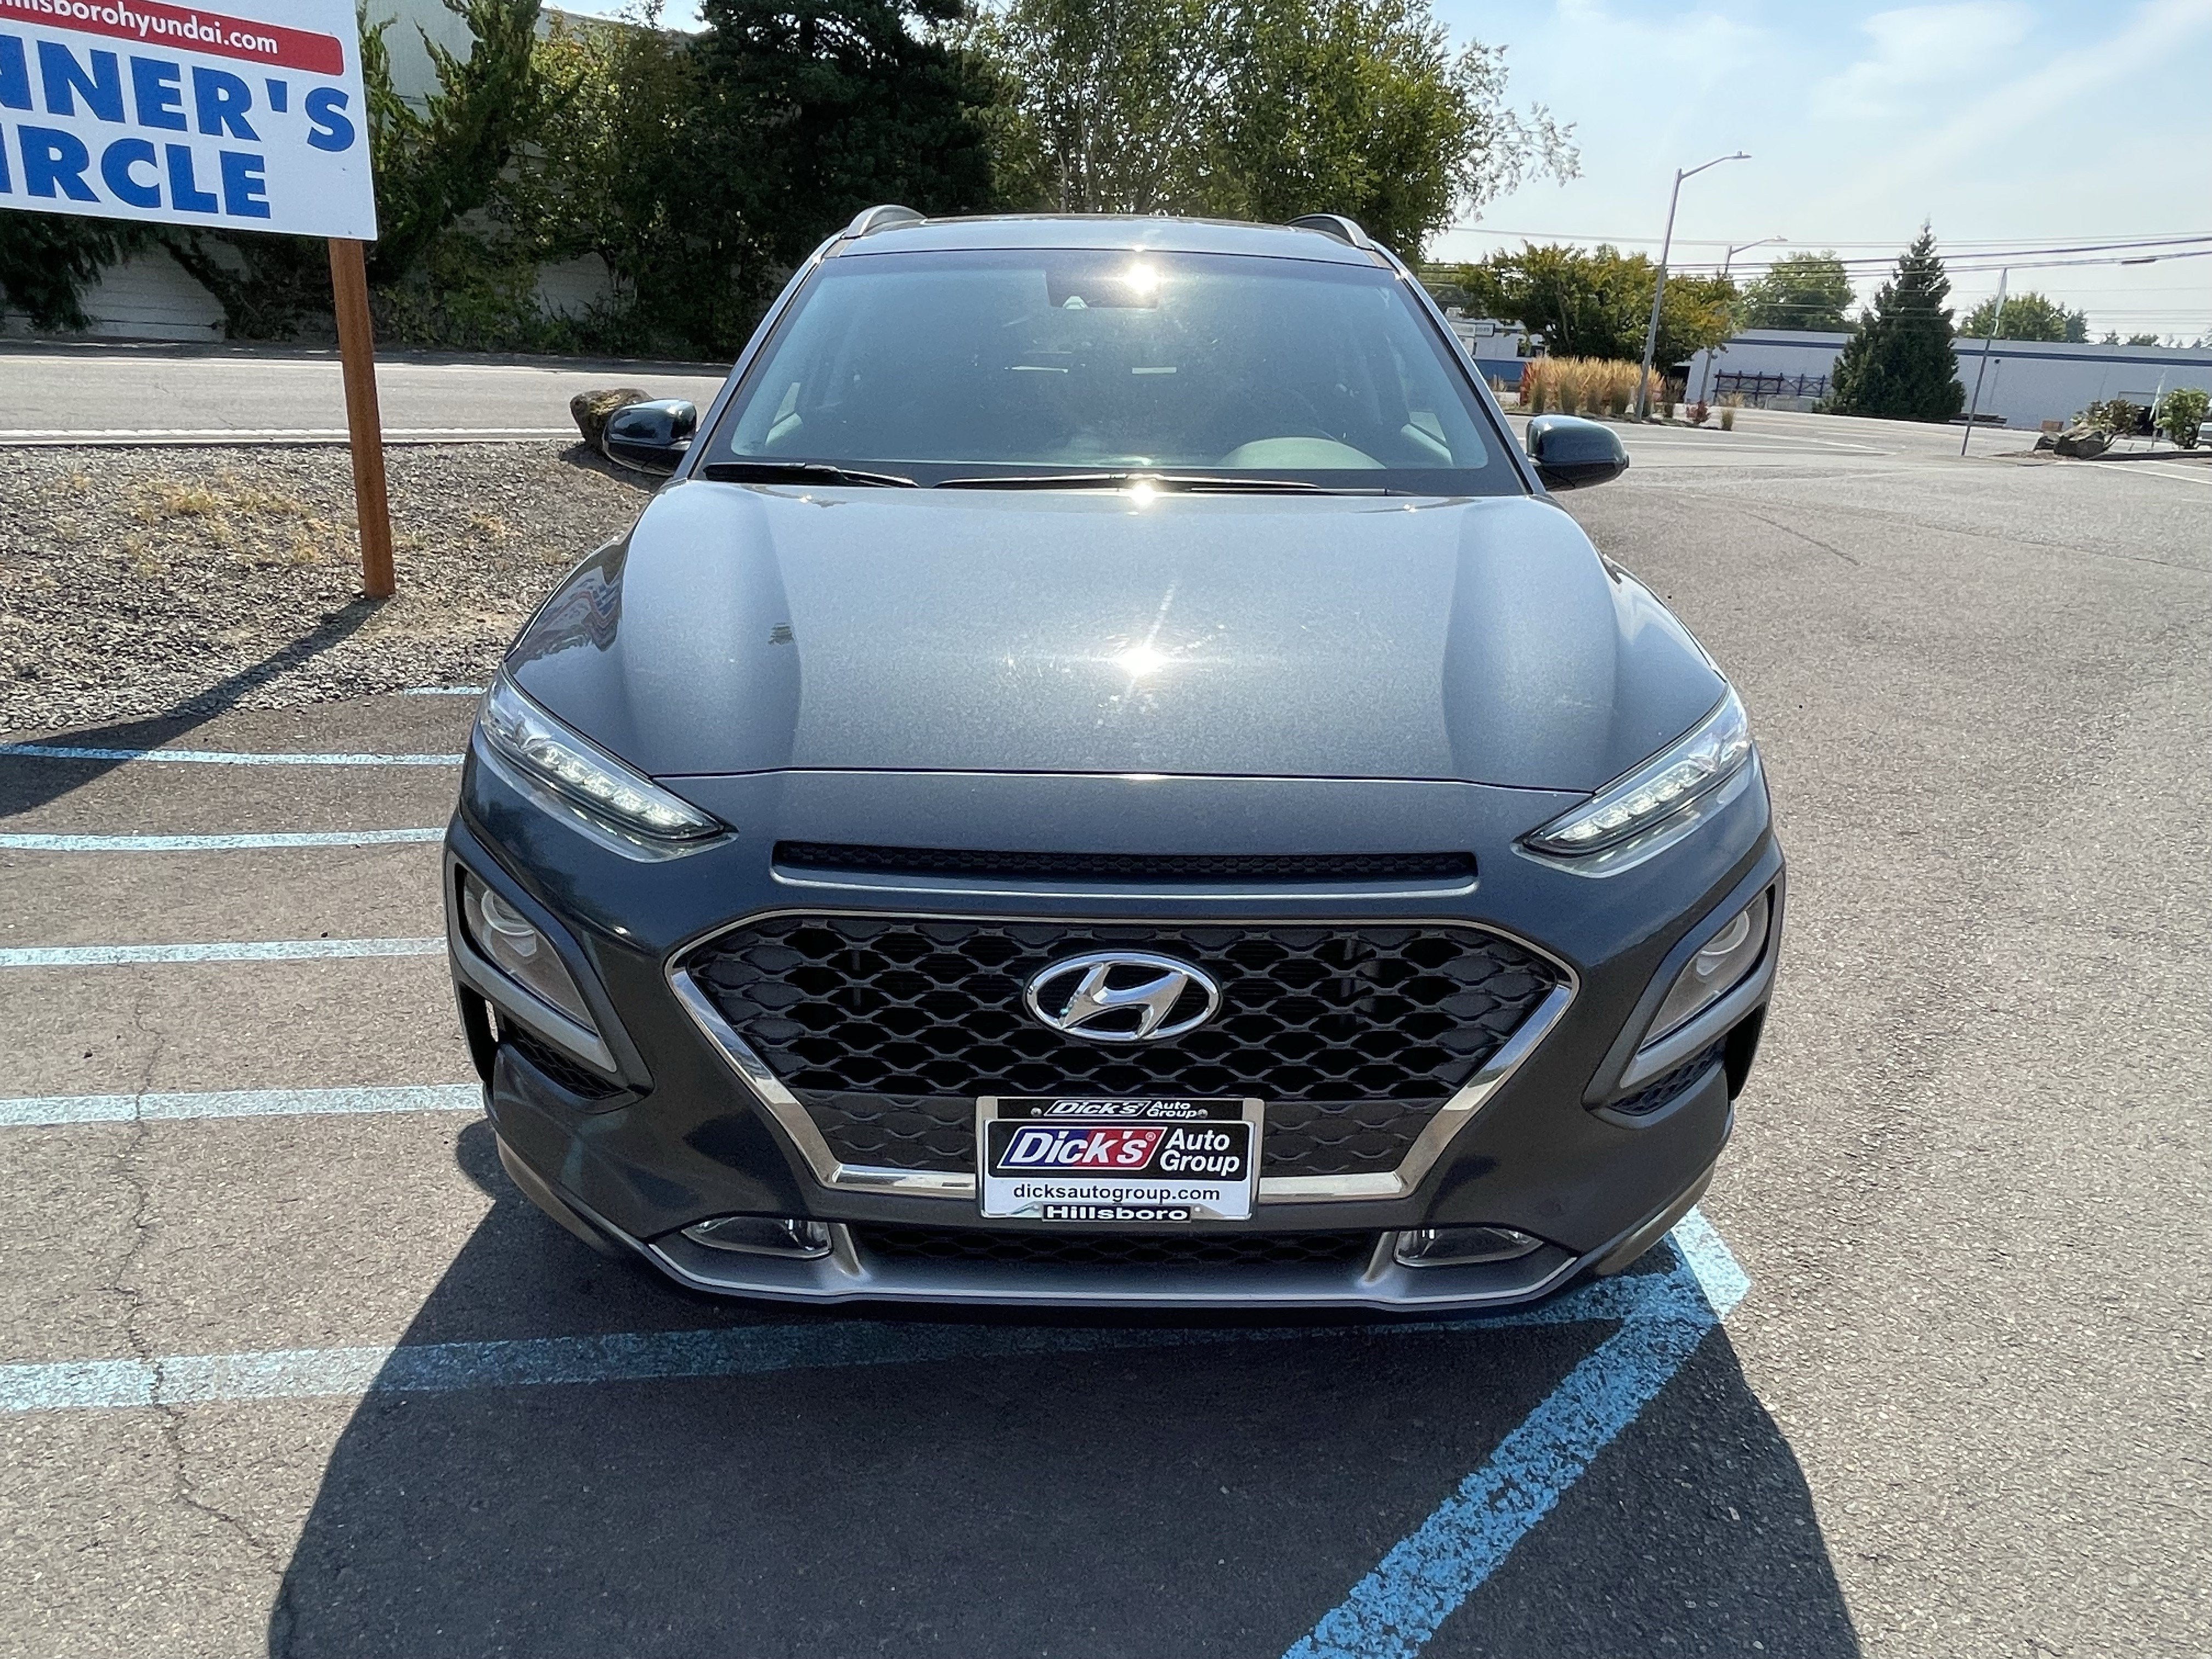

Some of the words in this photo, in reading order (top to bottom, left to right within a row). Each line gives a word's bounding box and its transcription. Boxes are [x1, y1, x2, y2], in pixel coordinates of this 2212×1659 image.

[0, 0, 278, 54] sborohyundai.com
[0, 122, 271, 219] RCLE
[1147, 1109, 1198, 1119] Group
[1152, 1101, 1191, 1109] Auto
[1164, 1128, 1231, 1151] Auto
[1160, 1149, 1240, 1177] Group
[1013, 1183, 1221, 1205] dicksautogroup.com
[1046, 1205, 1188, 1221] Hillsboro
